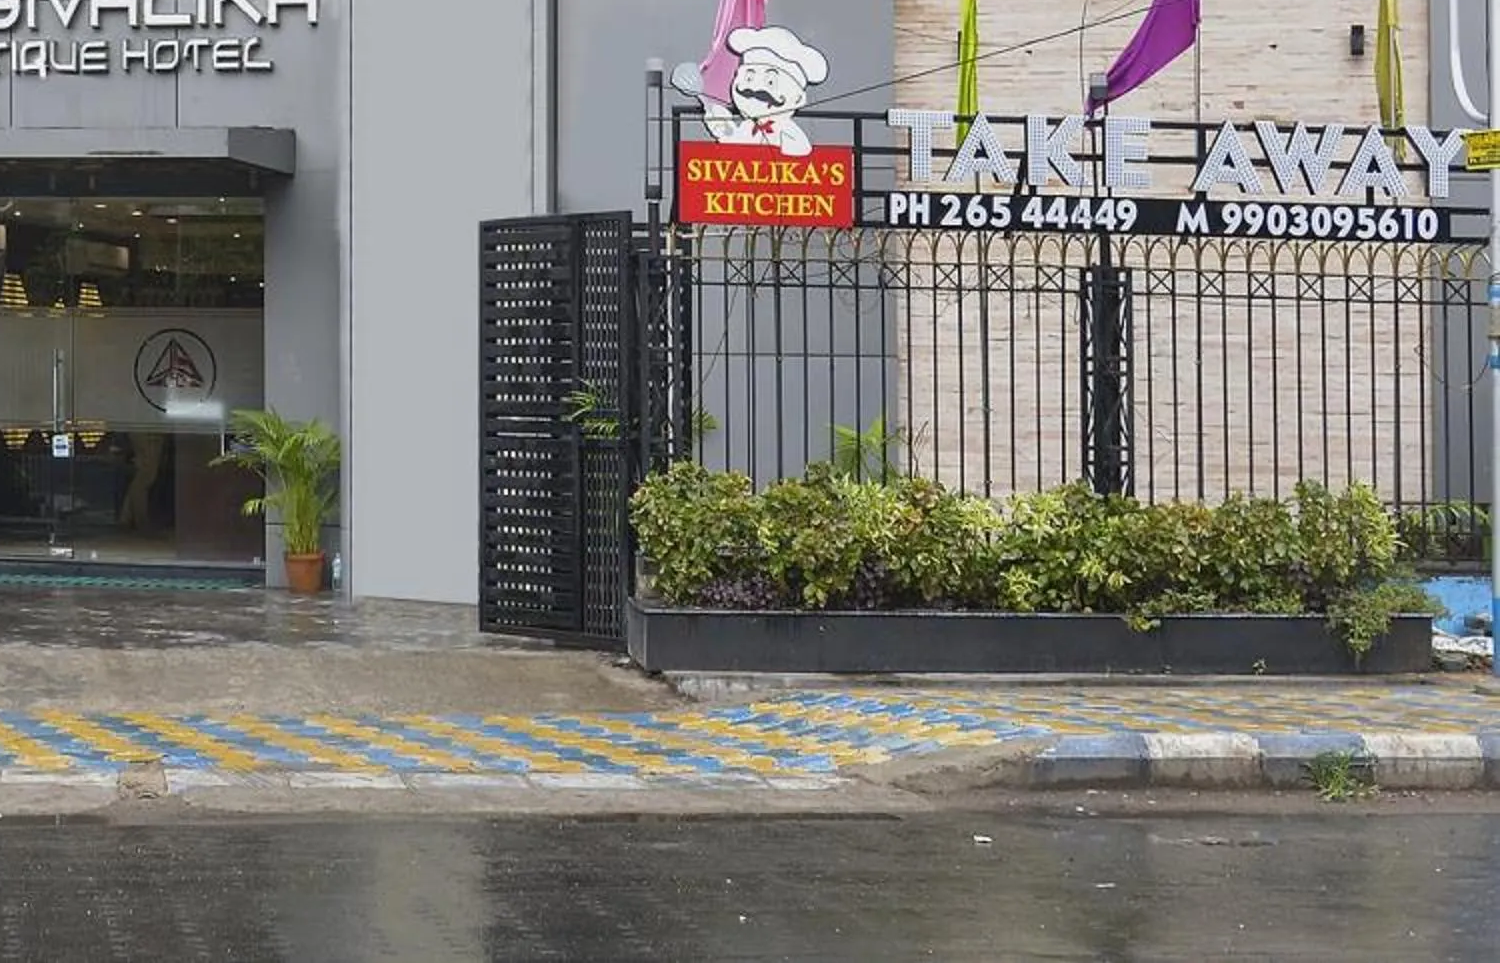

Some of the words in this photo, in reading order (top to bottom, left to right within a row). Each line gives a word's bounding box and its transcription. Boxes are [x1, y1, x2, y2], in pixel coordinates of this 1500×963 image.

[123, 37, 275, 74] HOTEL
[687, 158, 845, 186] SIVALIKA'S
[887, 108, 1151, 187] TAKE
[1190, 119, 1465, 199] AWAY
[704, 191, 836, 217] KITCHEN
[889, 193, 931, 226] PH
[940, 194, 1012, 227] 265
[1021, 197, 1138, 231] 44449
[1176, 202, 1210, 234] M
[1221, 203, 1439, 240] 9903095610
